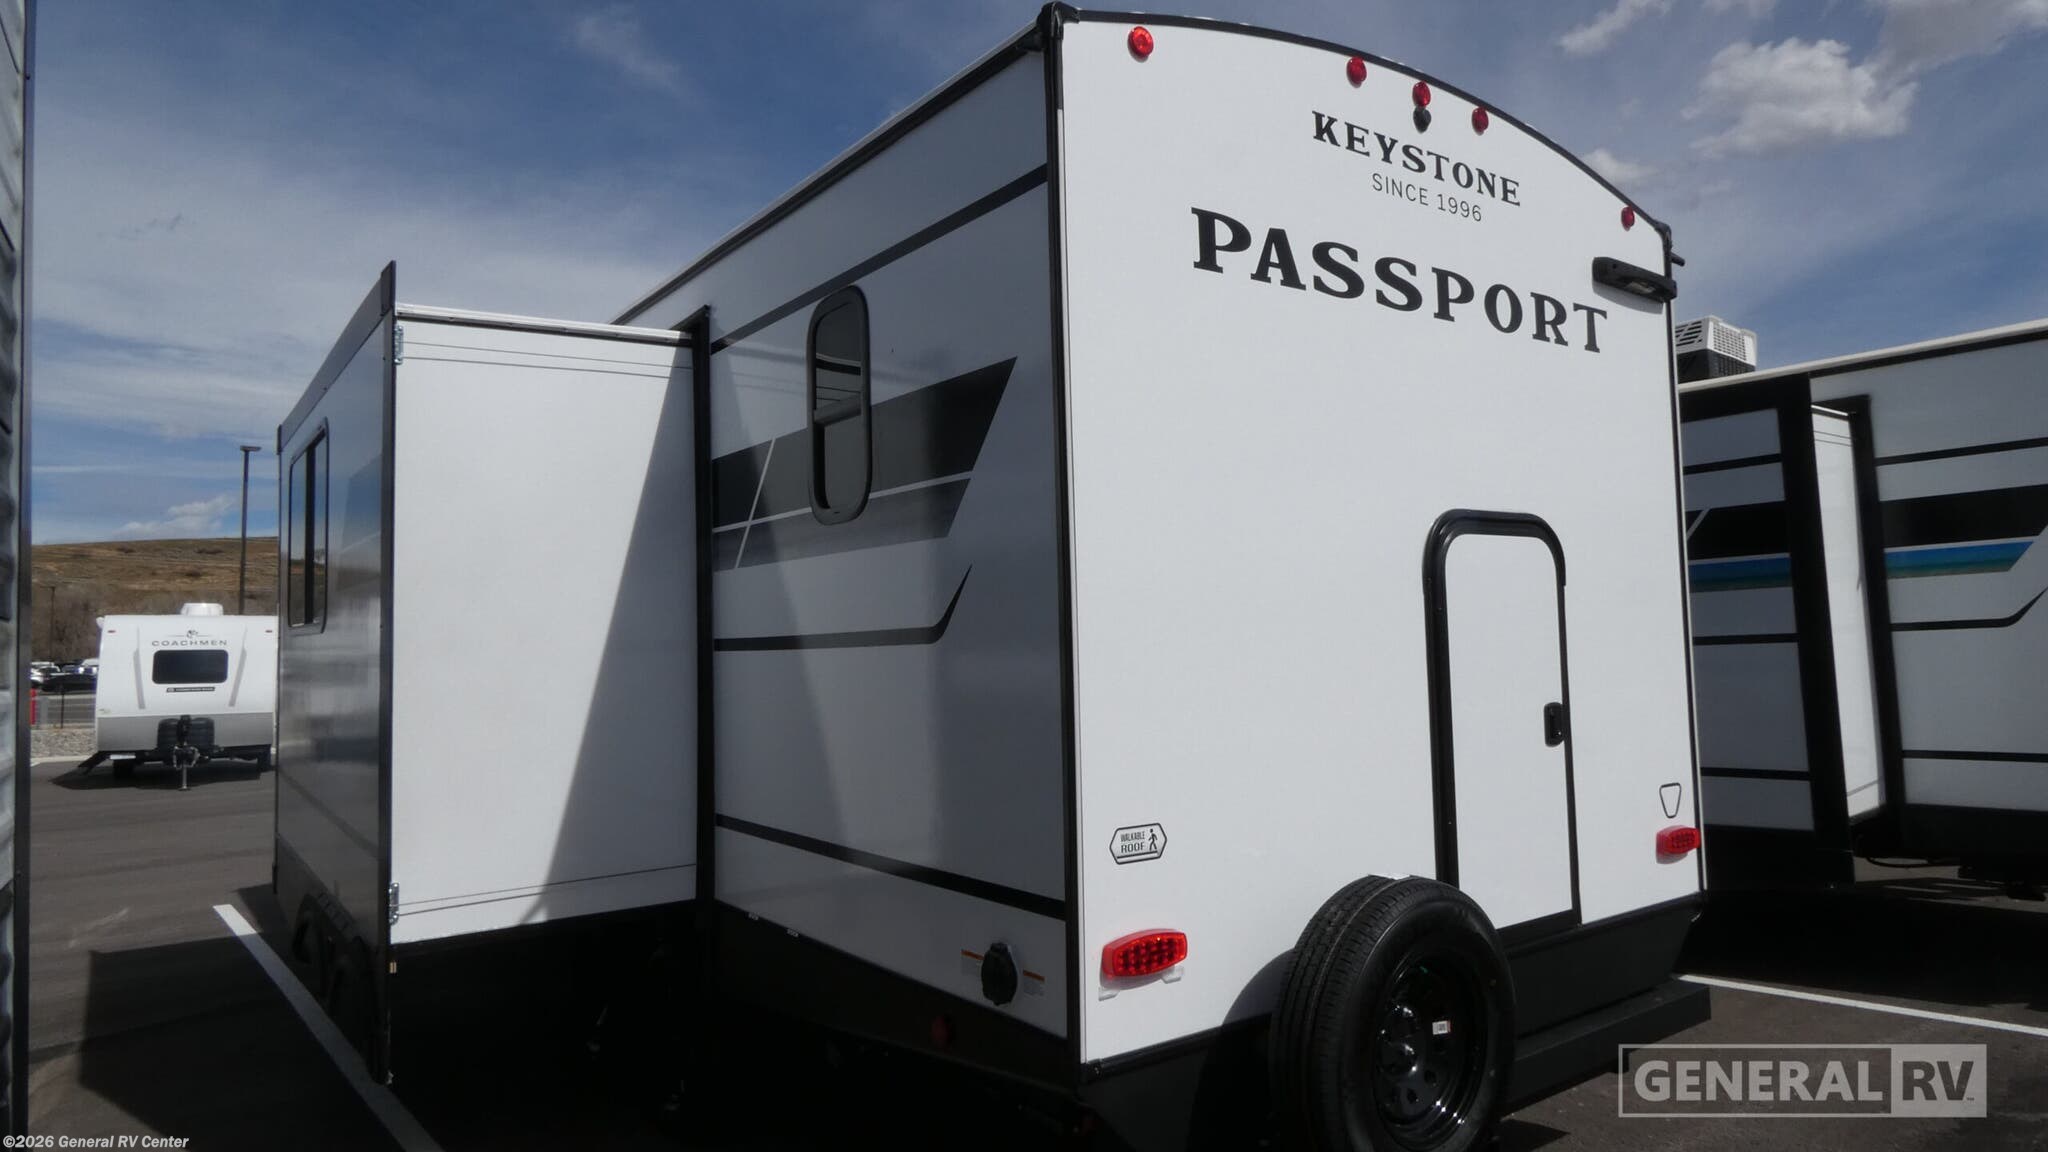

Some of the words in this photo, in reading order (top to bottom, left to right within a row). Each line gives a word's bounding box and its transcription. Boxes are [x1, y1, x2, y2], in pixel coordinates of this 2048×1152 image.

[1312, 110, 1520, 206] KEYSTONE
[1371, 172, 1429, 206] SINCE
[1437, 193, 1482, 222] 1996
[1191, 207, 1607, 353] PASSPORT
[1121, 842, 1145, 853] ROOF
